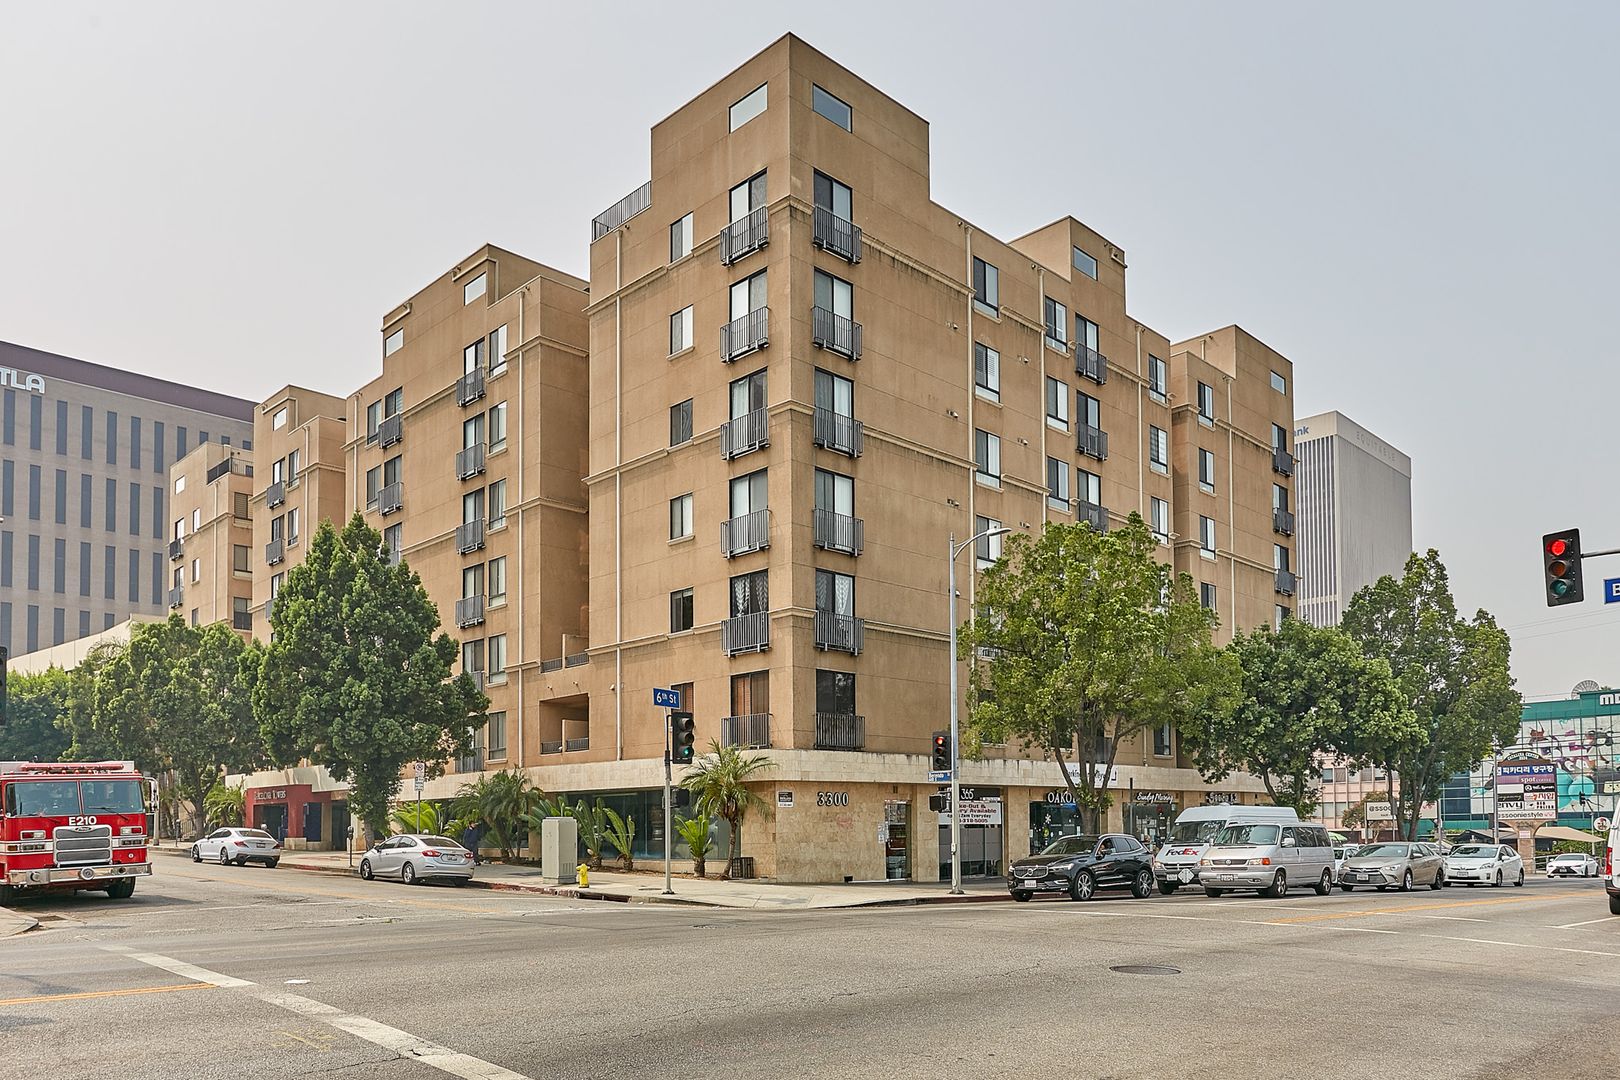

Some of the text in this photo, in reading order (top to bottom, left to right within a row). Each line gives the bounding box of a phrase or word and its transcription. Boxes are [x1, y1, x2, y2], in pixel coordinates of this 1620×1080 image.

[656, 691, 677, 704] 6th St
[816, 791, 849, 807] 3300
[960, 788, 975, 800] 365
[1047, 792, 1076, 803] OAKO
[68, 815, 98, 826] E210
[1166, 848, 1199, 856] FedEx
